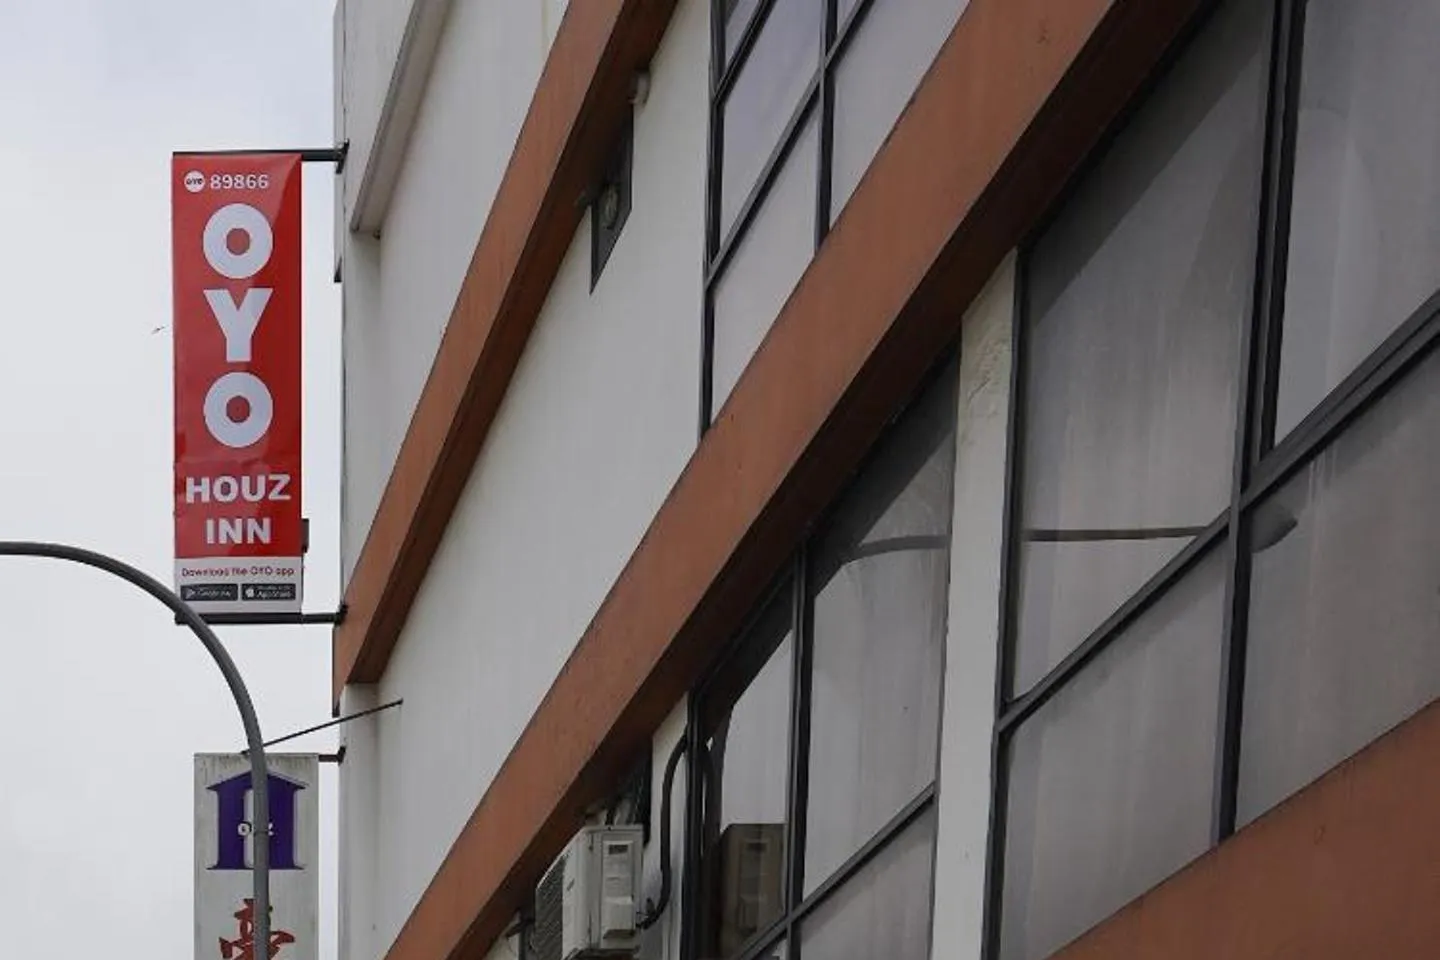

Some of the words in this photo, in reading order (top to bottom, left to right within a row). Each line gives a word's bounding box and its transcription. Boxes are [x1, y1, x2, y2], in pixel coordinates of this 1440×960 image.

[210, 174, 269, 189] 89866
[203, 203, 273, 447] OYO
[186, 475, 291, 504] HOUZ
[206, 518, 271, 545] INN
[182, 567, 229, 577] Download
